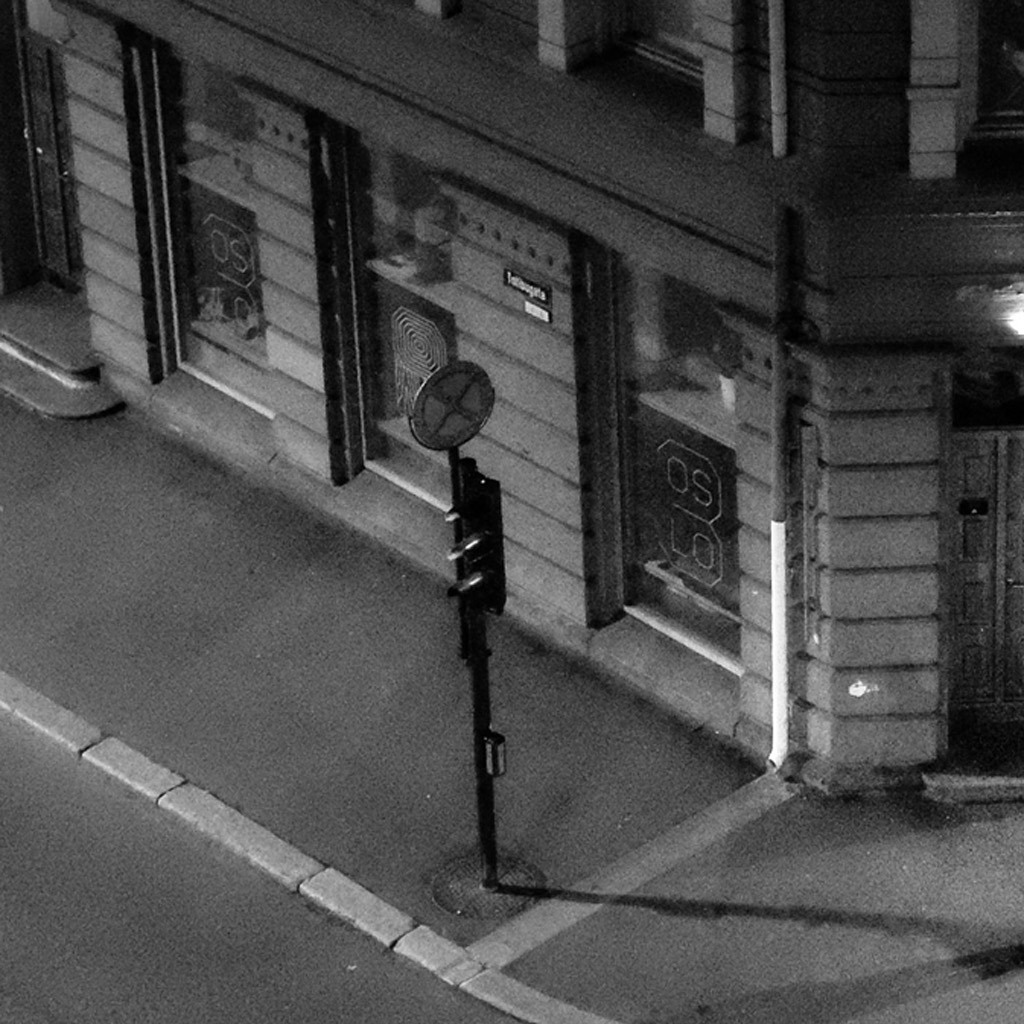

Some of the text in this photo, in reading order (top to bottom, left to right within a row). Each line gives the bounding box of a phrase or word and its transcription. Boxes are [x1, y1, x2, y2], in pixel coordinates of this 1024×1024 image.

[211, 229, 248, 273] OS
[667, 456, 713, 507] OS
[670, 517, 714, 570] LO
